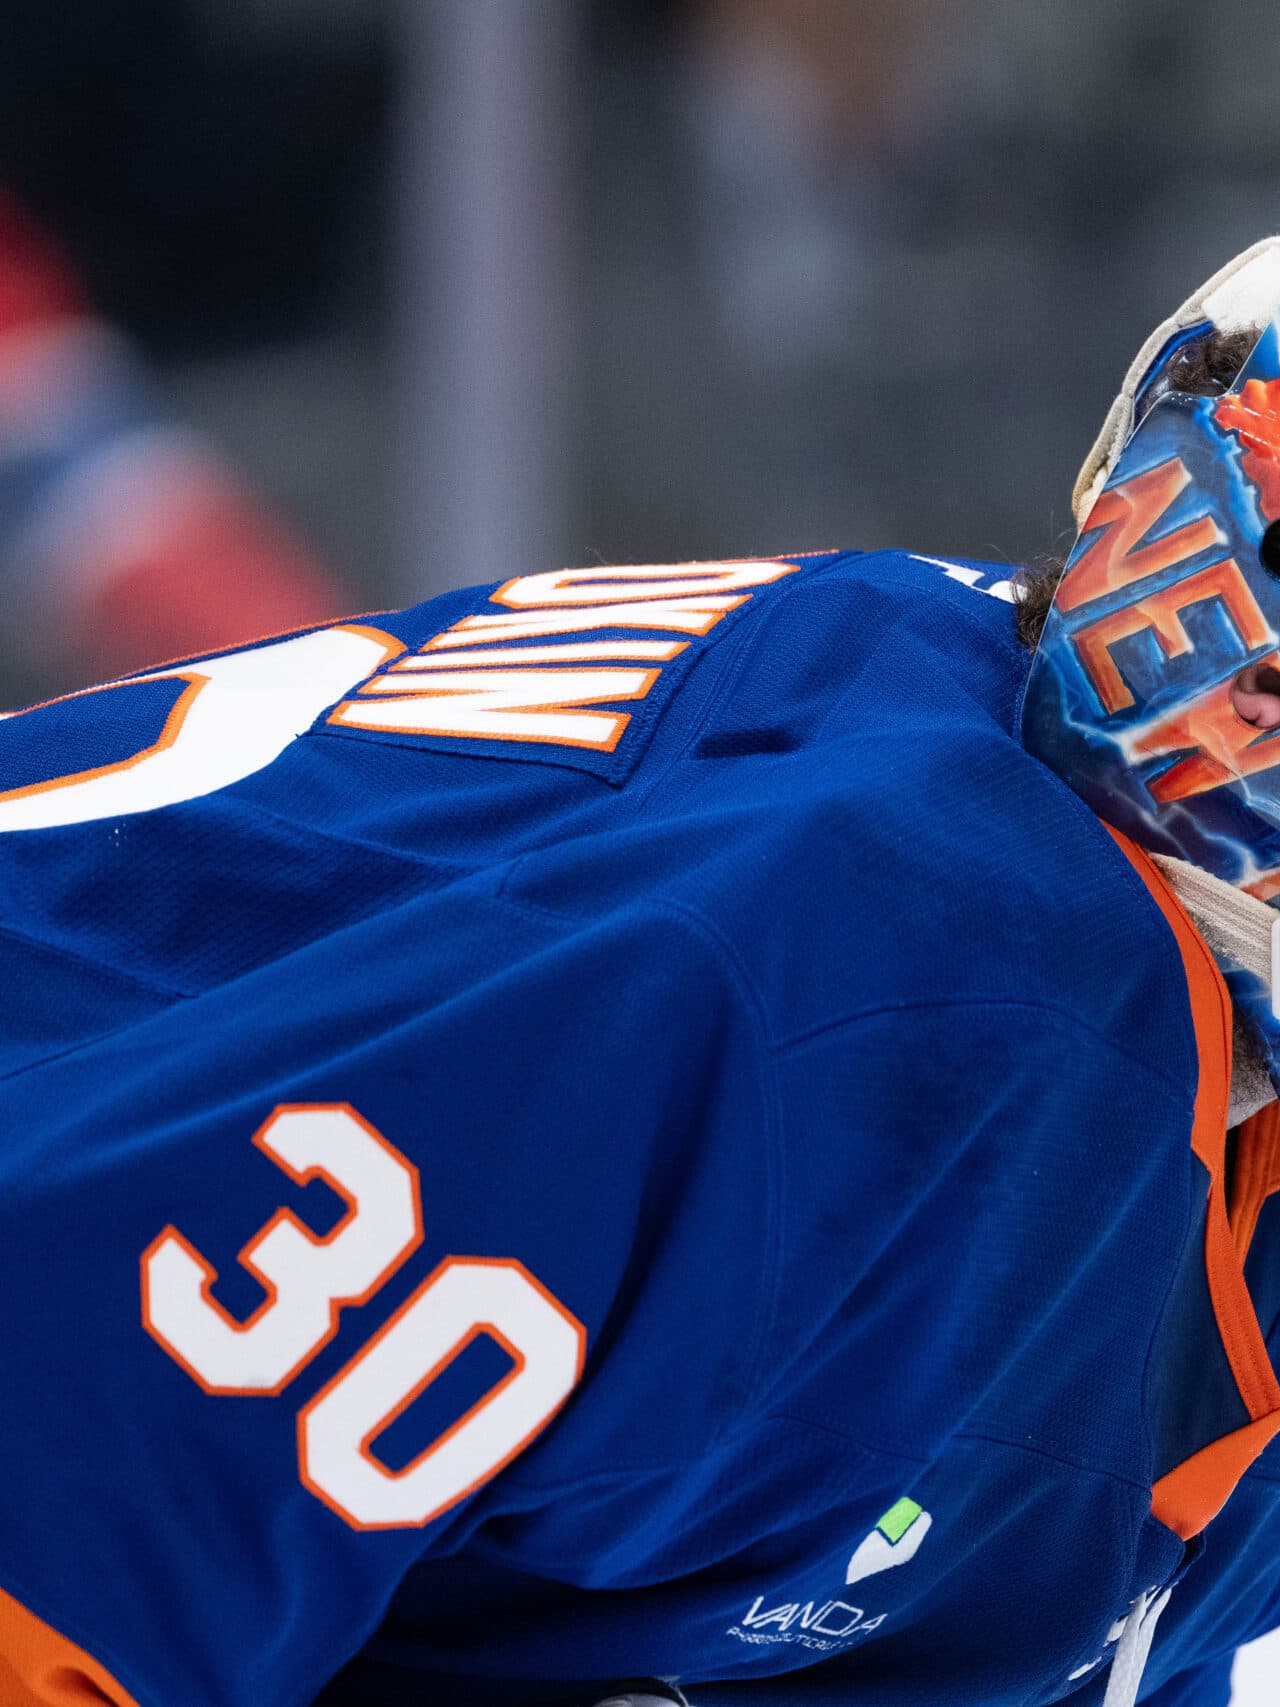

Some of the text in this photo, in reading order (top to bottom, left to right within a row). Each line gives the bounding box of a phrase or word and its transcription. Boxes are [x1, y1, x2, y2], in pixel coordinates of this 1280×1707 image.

[326, 553, 801, 753] OKIN
[140, 1102, 588, 1532] 30
[741, 1595, 888, 1636] VANDA
